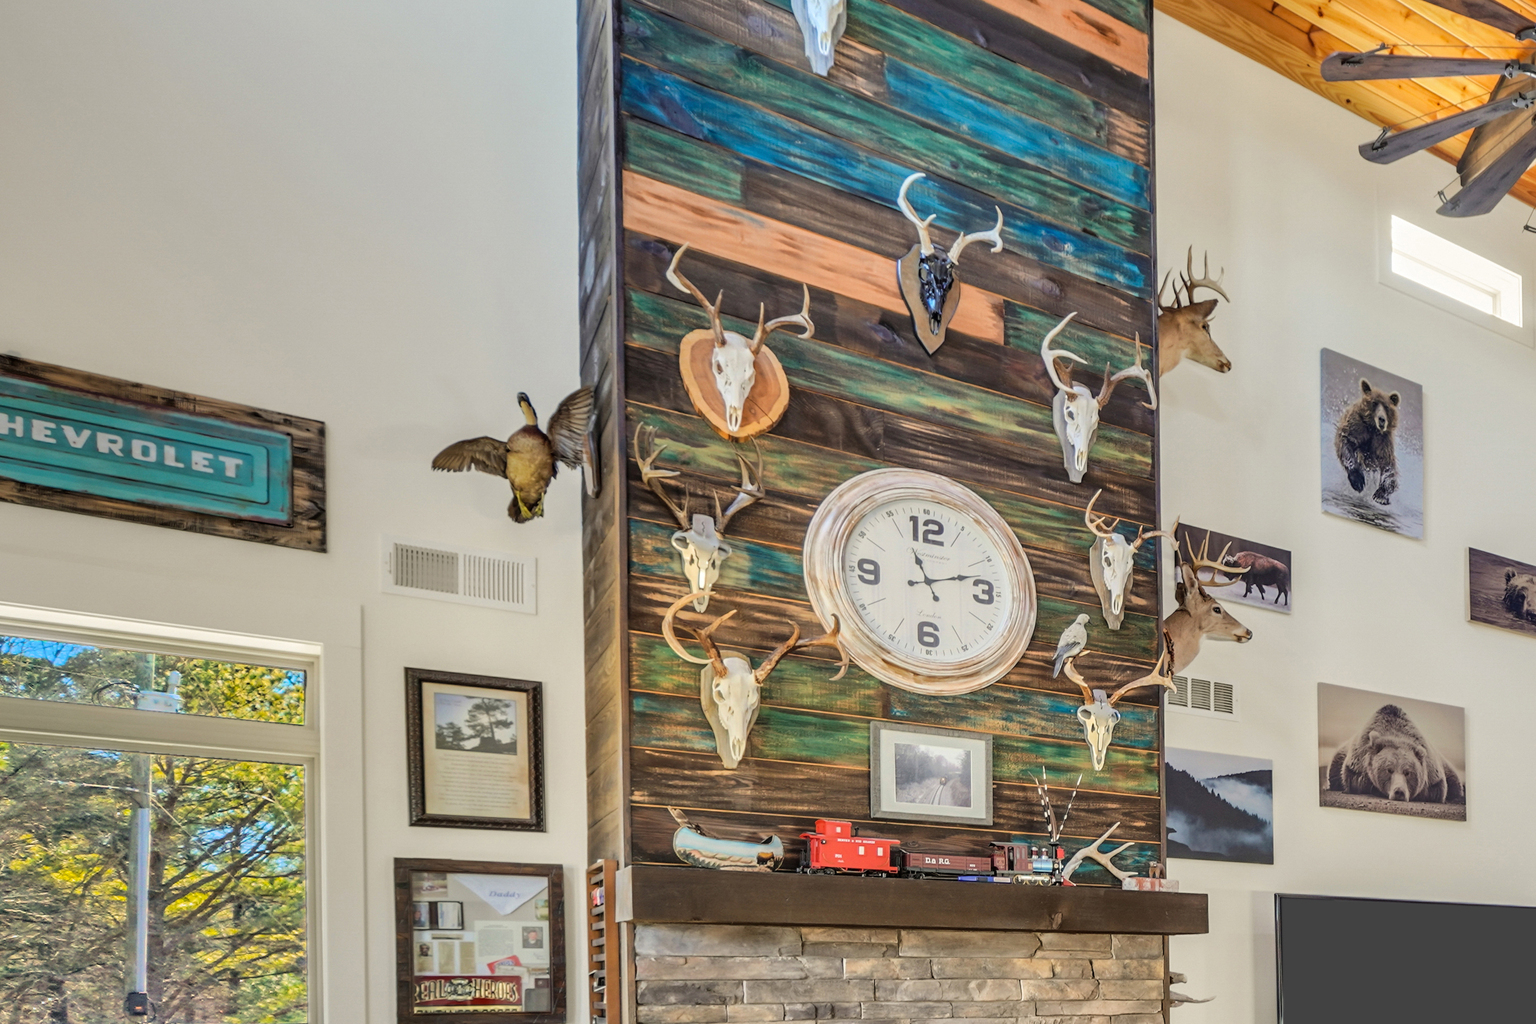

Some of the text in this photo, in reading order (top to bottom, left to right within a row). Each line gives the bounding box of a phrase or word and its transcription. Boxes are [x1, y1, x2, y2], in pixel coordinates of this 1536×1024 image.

[0, 412, 244, 479] HEVROLET
[885, 511, 894, 519] 55
[923, 508, 931, 516] 60
[858, 531, 867, 539] 50
[909, 515, 945, 547] 12
[857, 558, 881, 586] 9
[972, 578, 995, 606] 3
[916, 608, 942, 620] London
[917, 620, 940, 648] 6
[488, 890, 522, 899] Daddy
[471, 978, 519, 1003] HEROES
